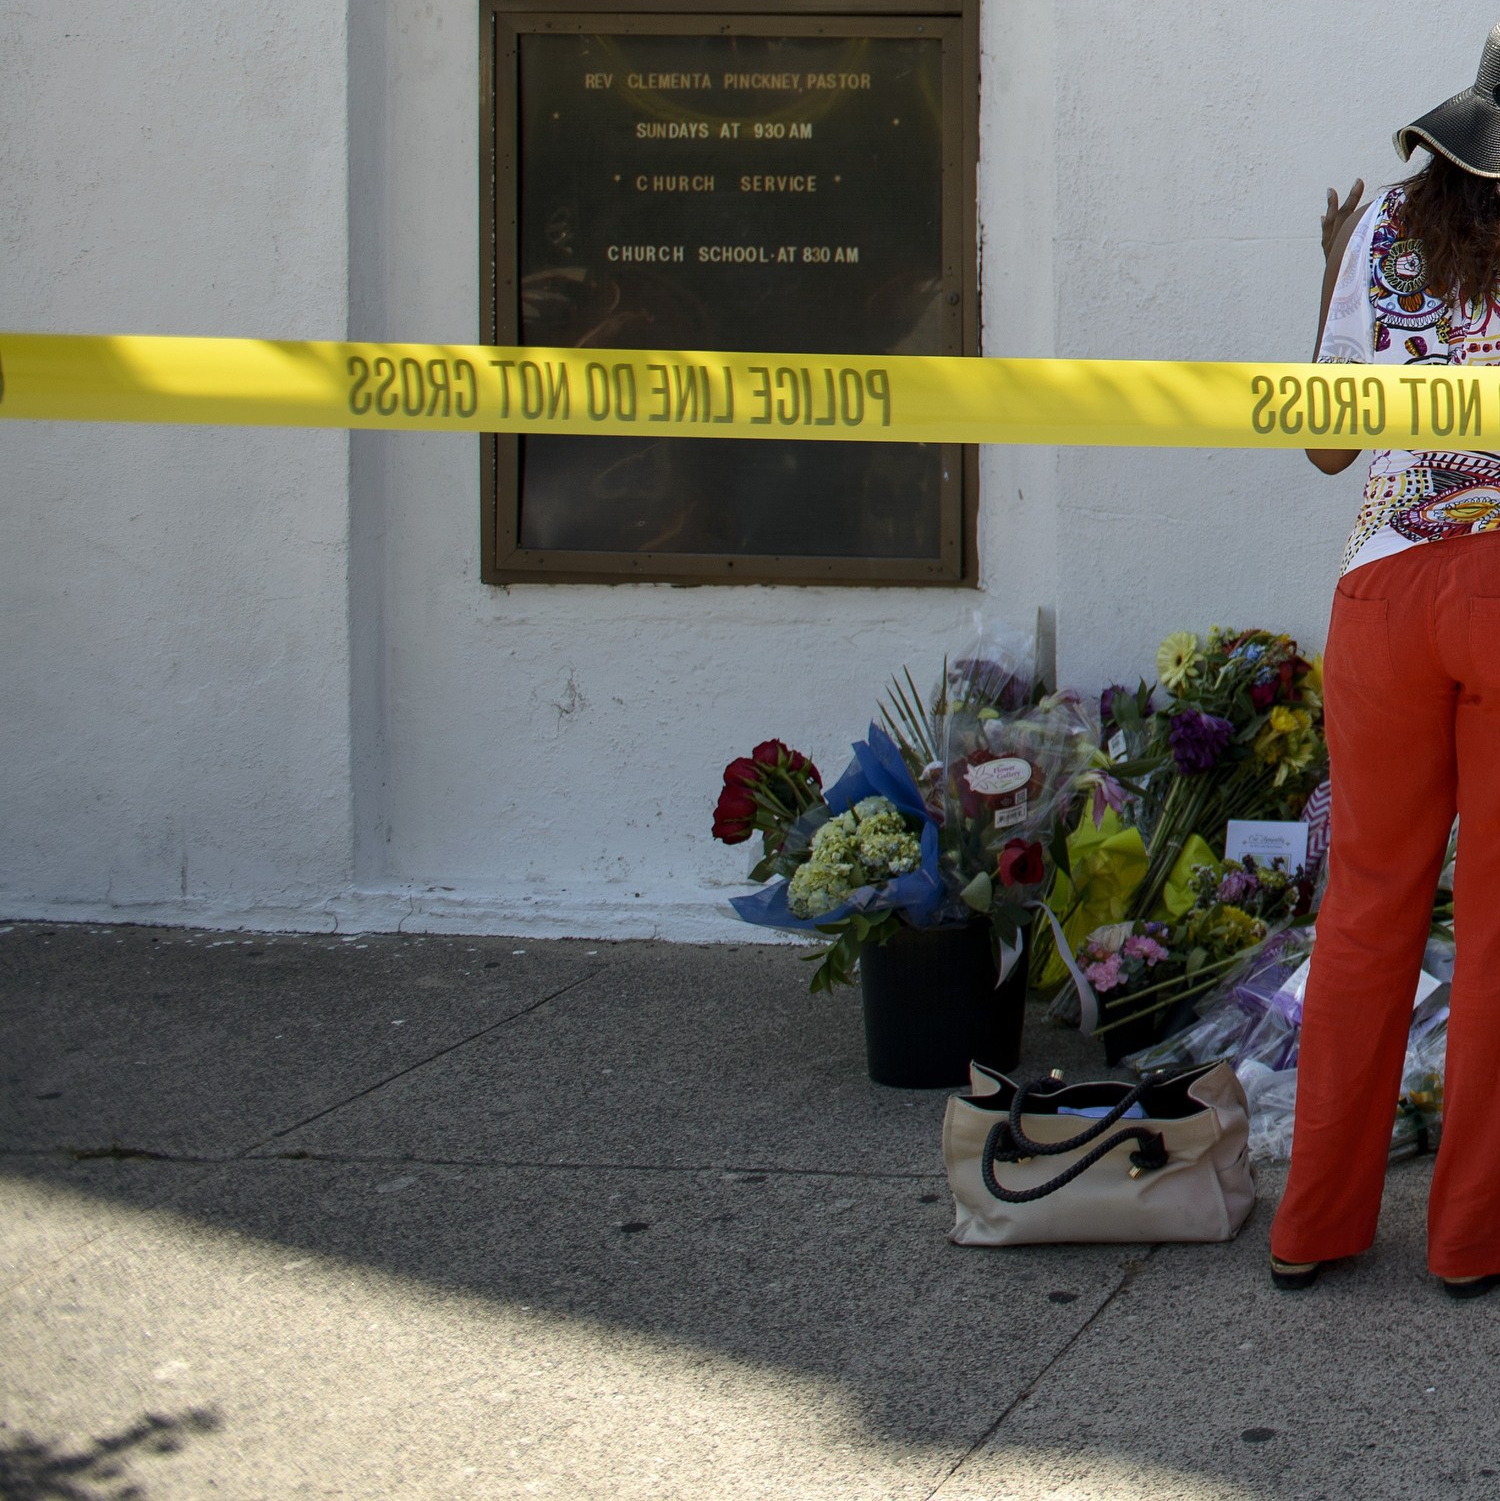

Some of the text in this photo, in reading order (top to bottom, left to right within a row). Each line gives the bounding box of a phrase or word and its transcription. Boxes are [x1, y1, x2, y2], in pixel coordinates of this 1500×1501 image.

[584, 73, 613, 90] REV
[626, 73, 712, 90] CLEMENTA
[806, 73, 872, 91] PASTOR
[635, 122, 813, 140] SUNDAYS AT 930 AM
[635, 175, 818, 193] CHURCH SERVICE
[607, 245, 685, 264] CHURCH
[801, 245, 831, 264] 830
[834, 245, 860, 264] AM
[993, 764, 1016, 774] Flower
[996, 770, 1021, 779] Gallery
